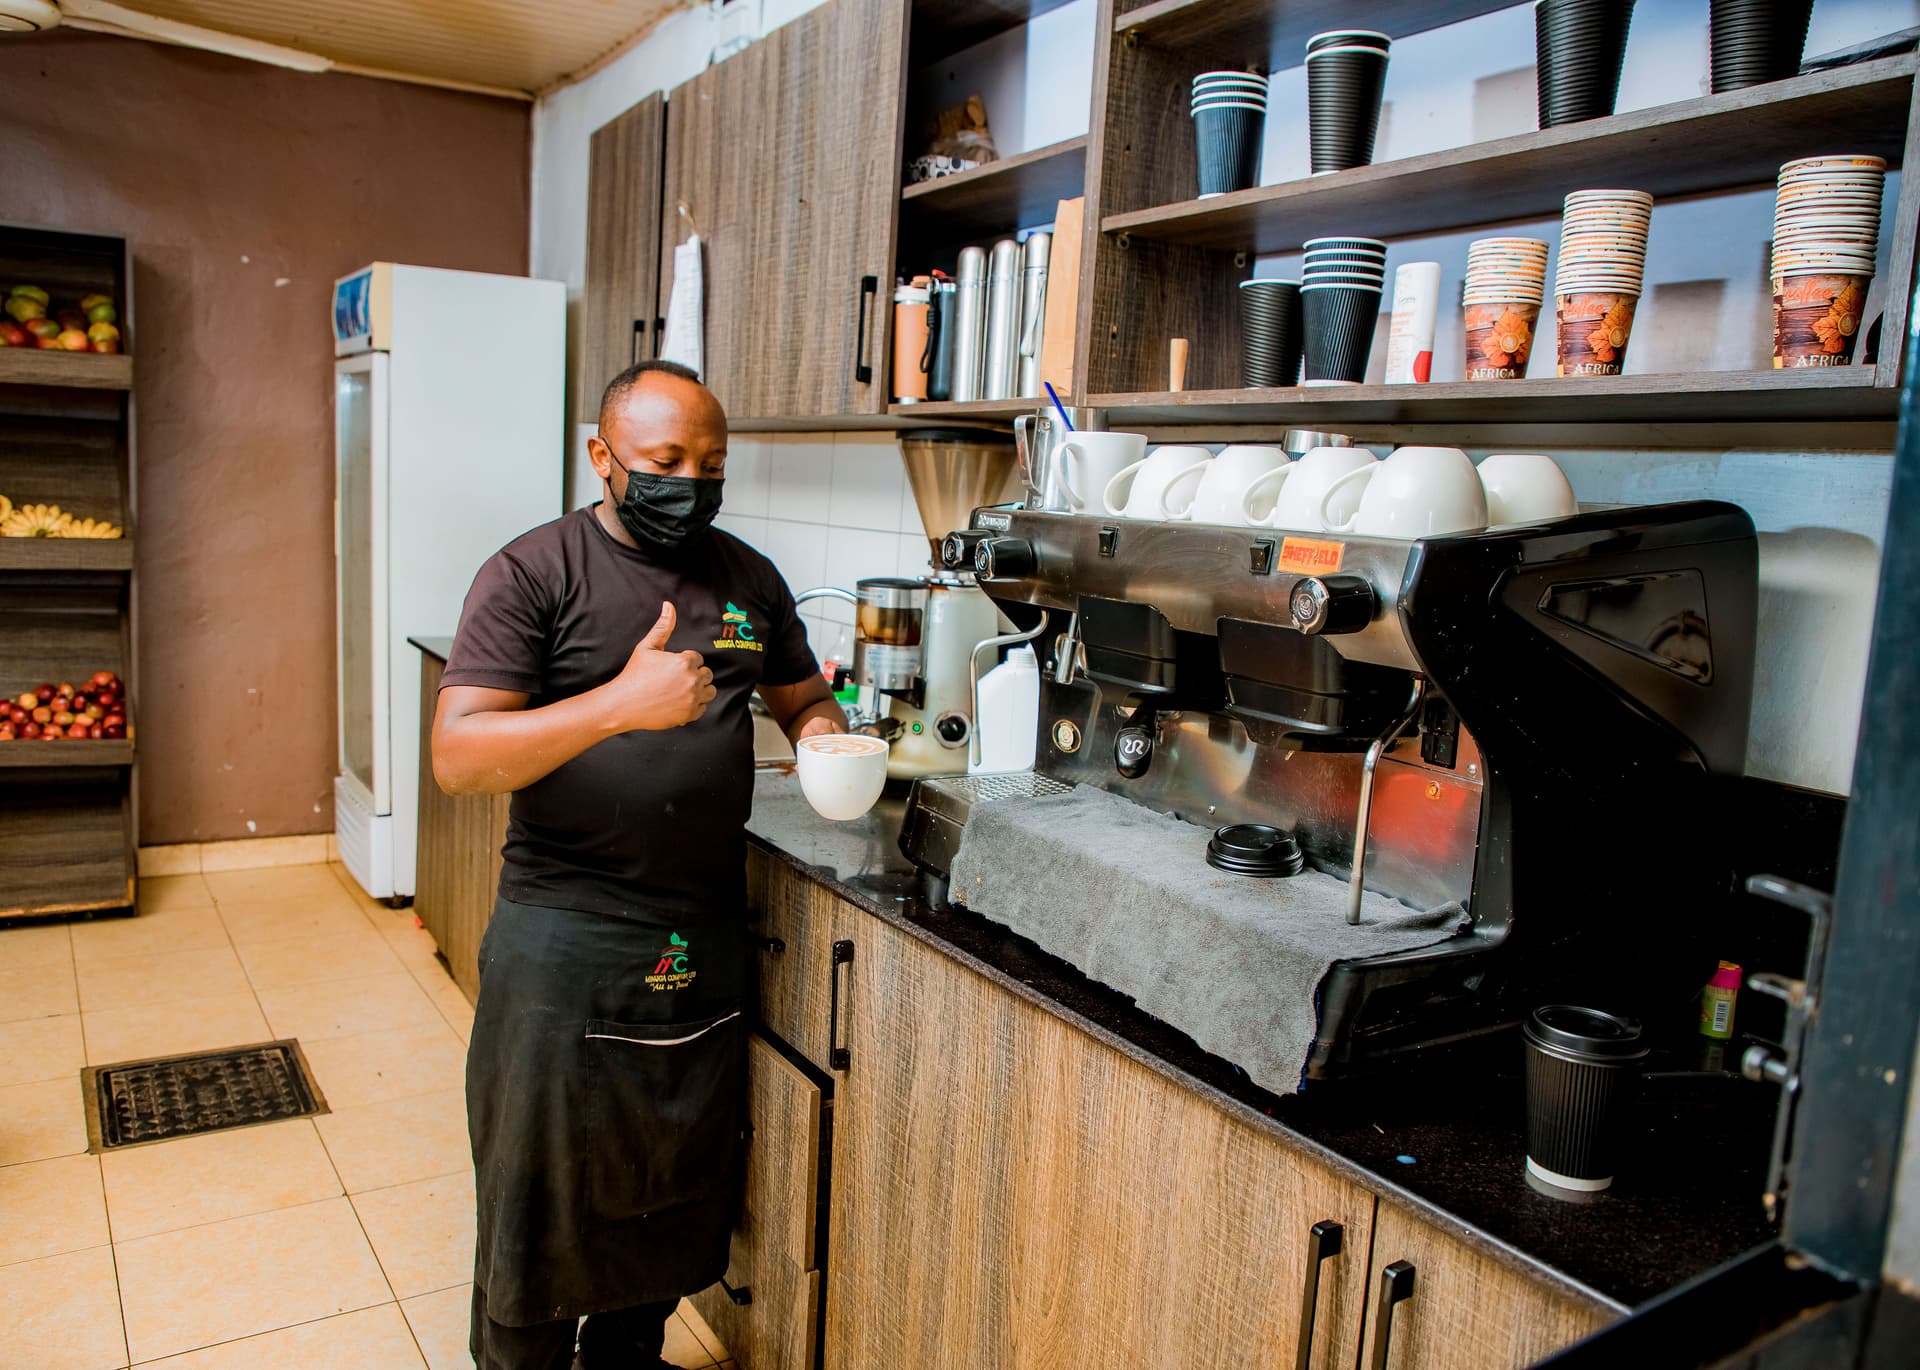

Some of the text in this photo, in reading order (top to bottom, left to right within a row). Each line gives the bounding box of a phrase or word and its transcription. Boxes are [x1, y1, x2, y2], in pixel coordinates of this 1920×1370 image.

[1784, 279, 1833, 304] coffee
[1794, 355, 1849, 368] AFRICA
[1471, 368, 1515, 379] AFRICA
[1574, 364, 1619, 374] AFRICA
